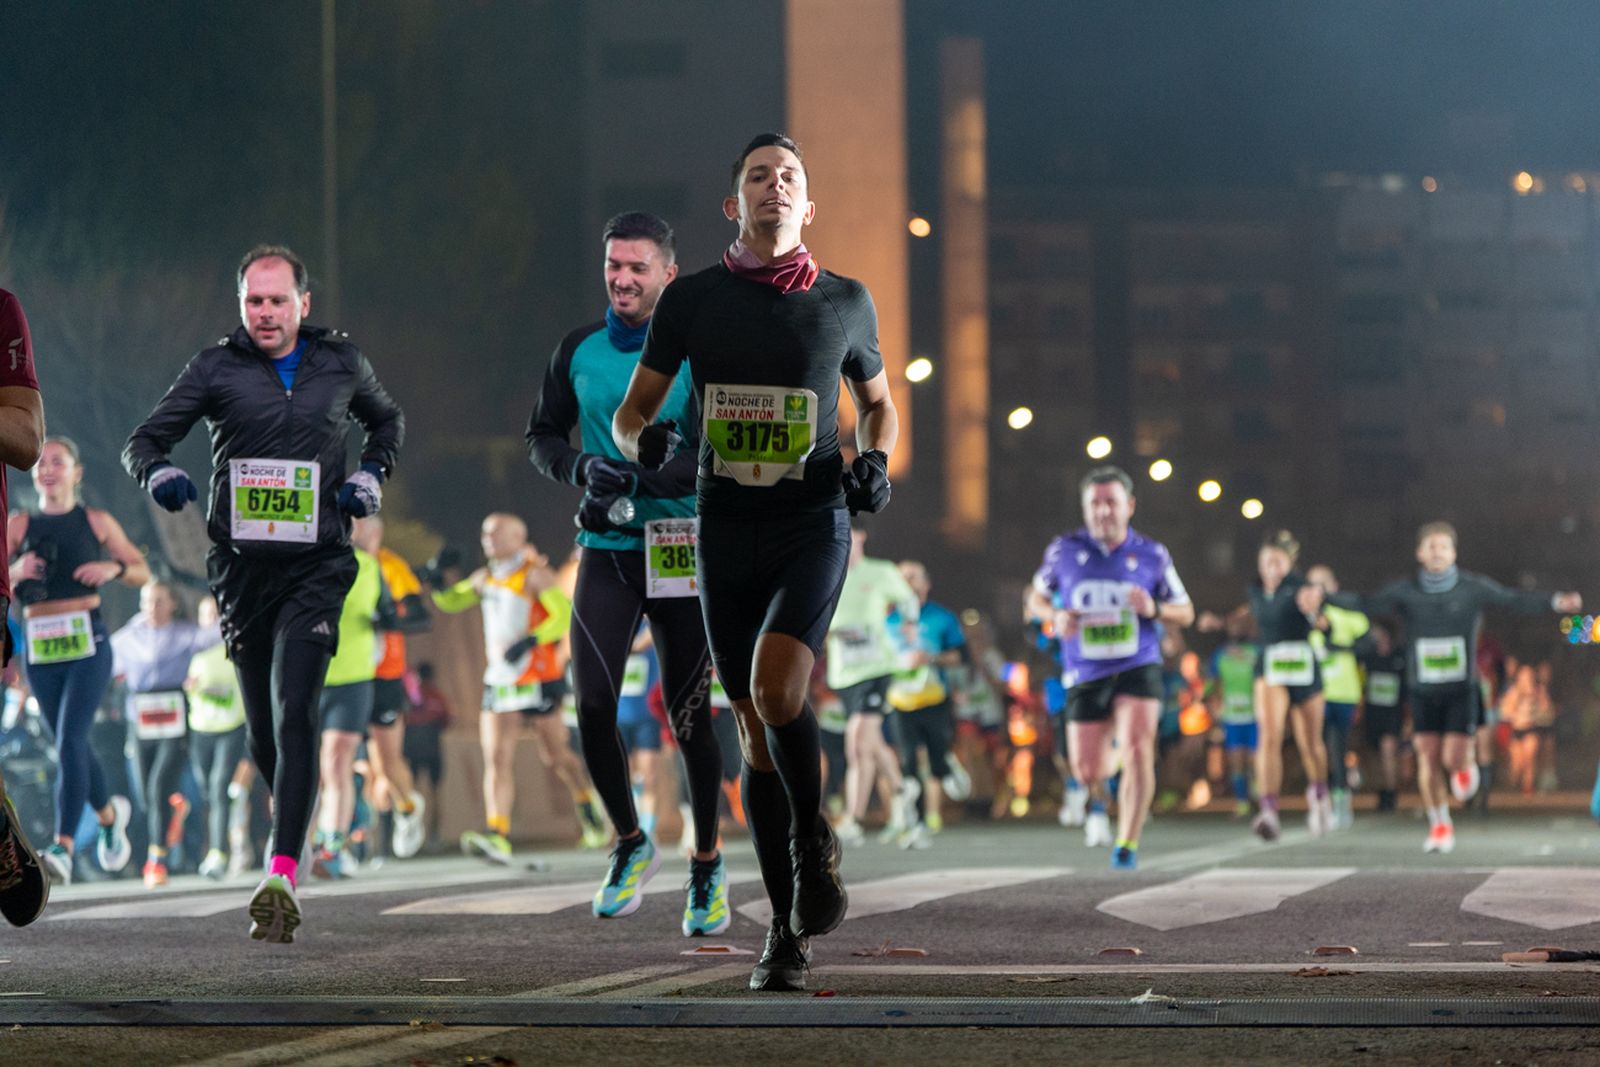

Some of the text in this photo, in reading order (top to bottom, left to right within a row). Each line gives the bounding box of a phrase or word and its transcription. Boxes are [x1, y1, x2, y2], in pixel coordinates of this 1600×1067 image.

[727, 397, 775, 408] NOCHE DE
[715, 408, 736, 419] SAN
[727, 421, 789, 452] 3175
[250, 468, 275, 476] NOCHE
[241, 478, 256, 486] SAN
[248, 488, 300, 513] 6754
